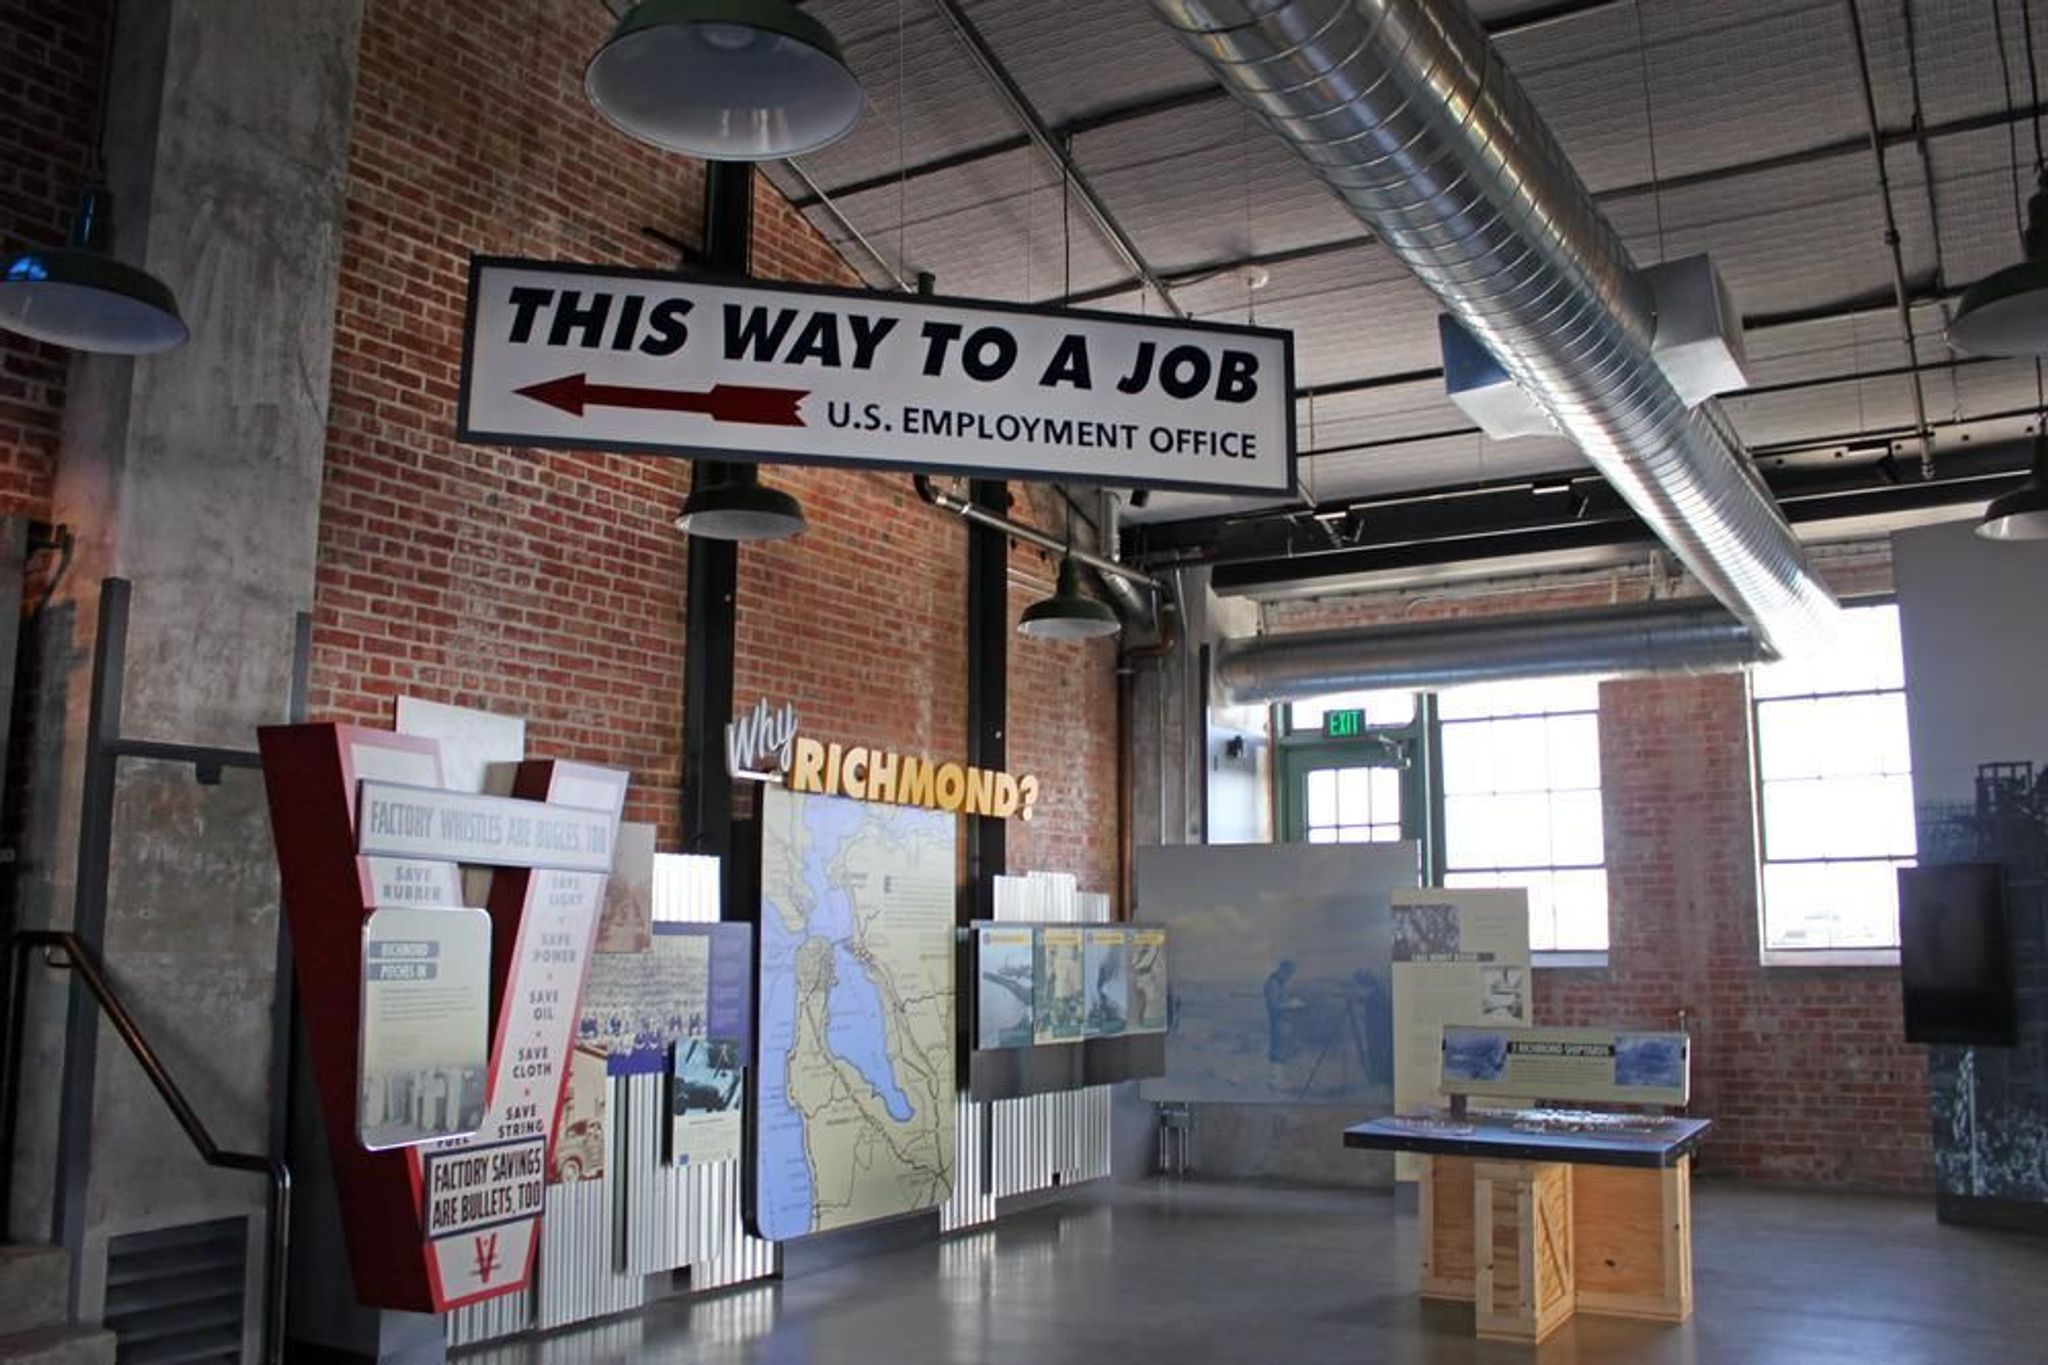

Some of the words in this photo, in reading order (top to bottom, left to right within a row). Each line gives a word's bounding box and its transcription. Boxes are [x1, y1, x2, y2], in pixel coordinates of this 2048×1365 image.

[509, 286, 695, 356] THIS
[723, 303, 898, 370] WAY
[921, 322, 1018, 382] TO
[1039, 334, 1092, 390] A
[1116, 342, 1260, 403] JOB
[828, 401, 892, 432] U.S.
[903, 407, 1139, 450] EMPLOYMENT
[1149, 426, 1257, 459] OFFICE
[1330, 711, 1359, 736] EXIT
[725, 697, 799, 774] Why
[789, 736, 1039, 821] RICHMOND?
[371, 801, 435, 838] FACTORY
[441, 808, 501, 844] WHISTLES
[506, 816, 530, 849] ARE
[395, 867, 431, 883] SAVE
[383, 885, 441, 901] RUBBER
[541, 933, 571, 947] SAVE
[534, 949, 576, 963] POWER
[530, 989, 559, 1004] SAVE
[534, 1007, 554, 1020] OIL
[518, 1046, 549, 1061] SAVE
[512, 1063, 551, 1078] CLOTH
[506, 1104, 537, 1121] SAVE
[498, 1119, 544, 1138] STRING
[434, 1155, 489, 1194] FACTORY
[492, 1148, 541, 1182] SAVINGS
[433, 1197, 458, 1229] ARE
[518, 1180, 541, 1210] TOO
